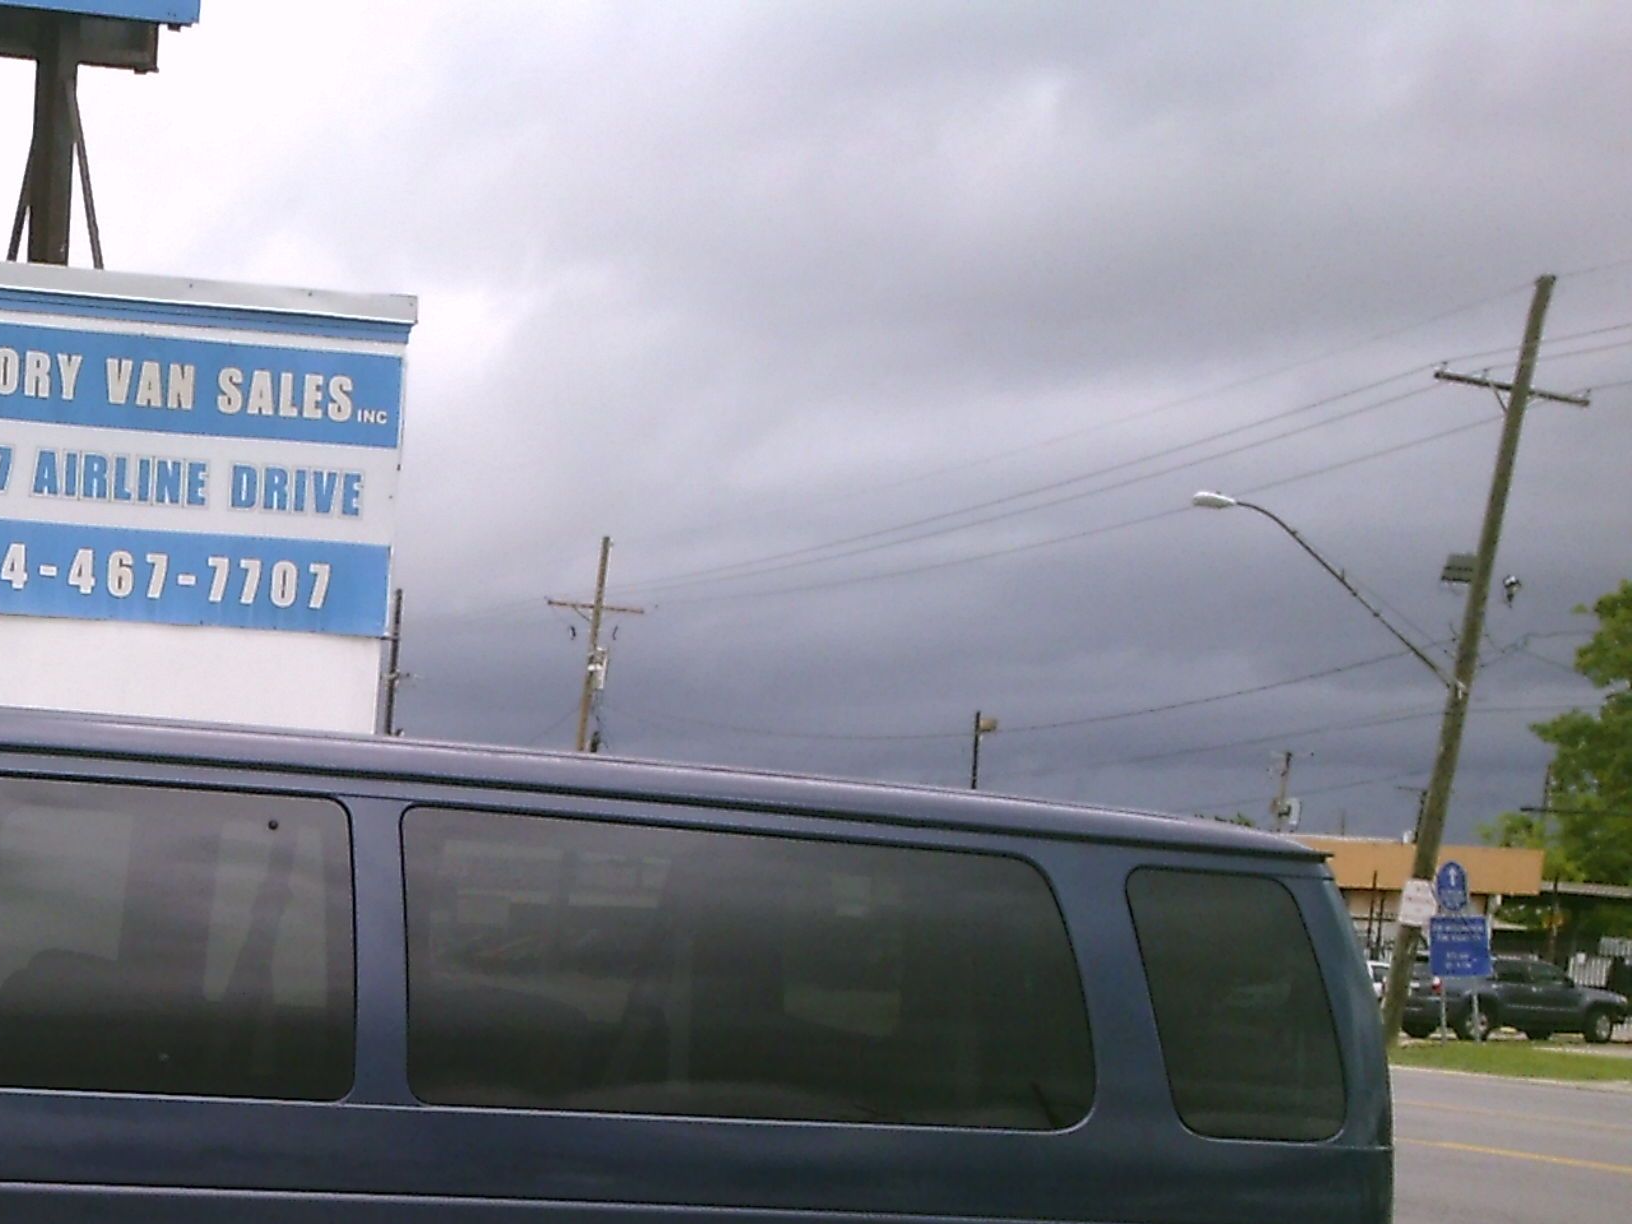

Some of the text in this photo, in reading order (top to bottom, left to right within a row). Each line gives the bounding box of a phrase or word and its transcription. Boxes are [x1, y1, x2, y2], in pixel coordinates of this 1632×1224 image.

[106, 357, 196, 411] VAN
[217, 367, 354, 422] SALES
[357, 409, 388, 425] INC
[31, 448, 208, 507] AIRLINE
[231, 463, 363, 519] DRIVE
